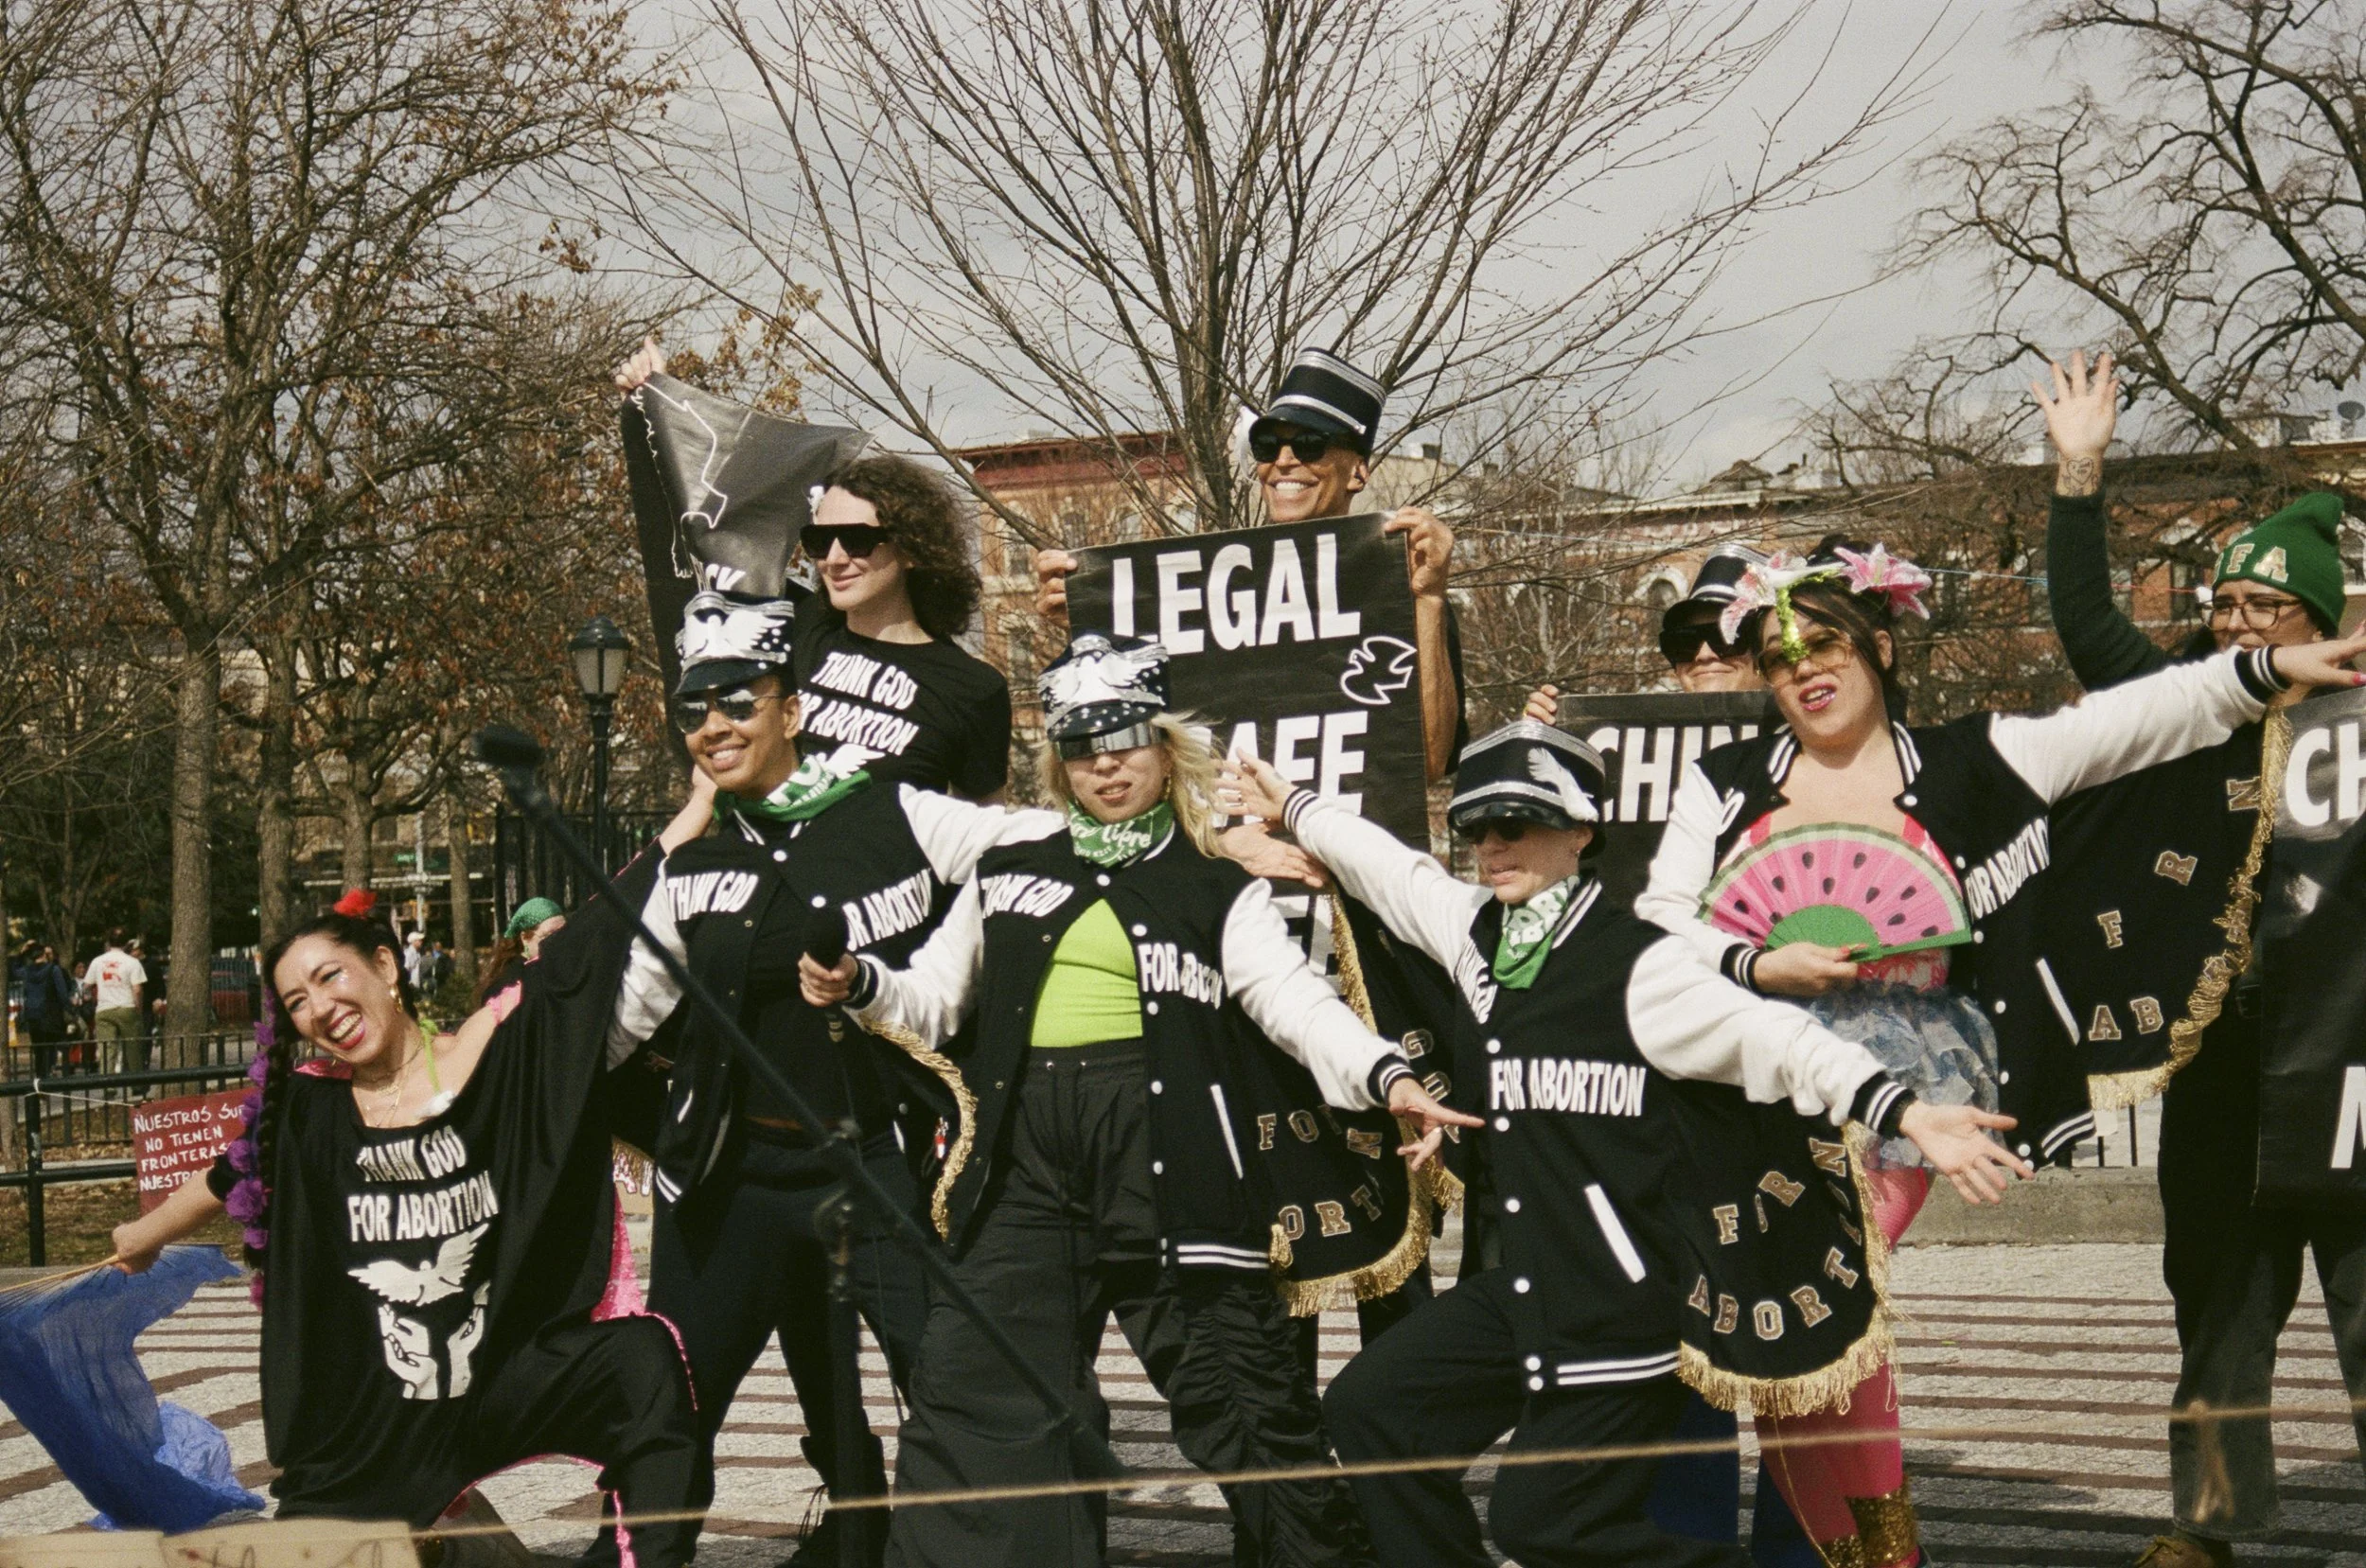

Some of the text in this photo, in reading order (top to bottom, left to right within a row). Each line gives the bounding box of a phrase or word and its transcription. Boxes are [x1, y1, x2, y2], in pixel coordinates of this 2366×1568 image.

[2212, 543, 2289, 584] FA
[1113, 533, 1361, 656] LEGAL
[810, 651, 918, 710] THANK GOD
[808, 699, 919, 756] ABORTION
[1185, 711, 1368, 829] AFE
[710, 871, 759, 913] GOD
[1014, 878, 1075, 918] GOD
[1138, 943, 1181, 993] FOR
[1492, 1058, 1647, 1117] FOR ABORTION
[134, 1105, 212, 1135] NUESTROS
[146, 1137, 164, 1154] NO
[420, 1124, 467, 1179] GOD
[347, 1170, 499, 1242] FOR ABORTION
